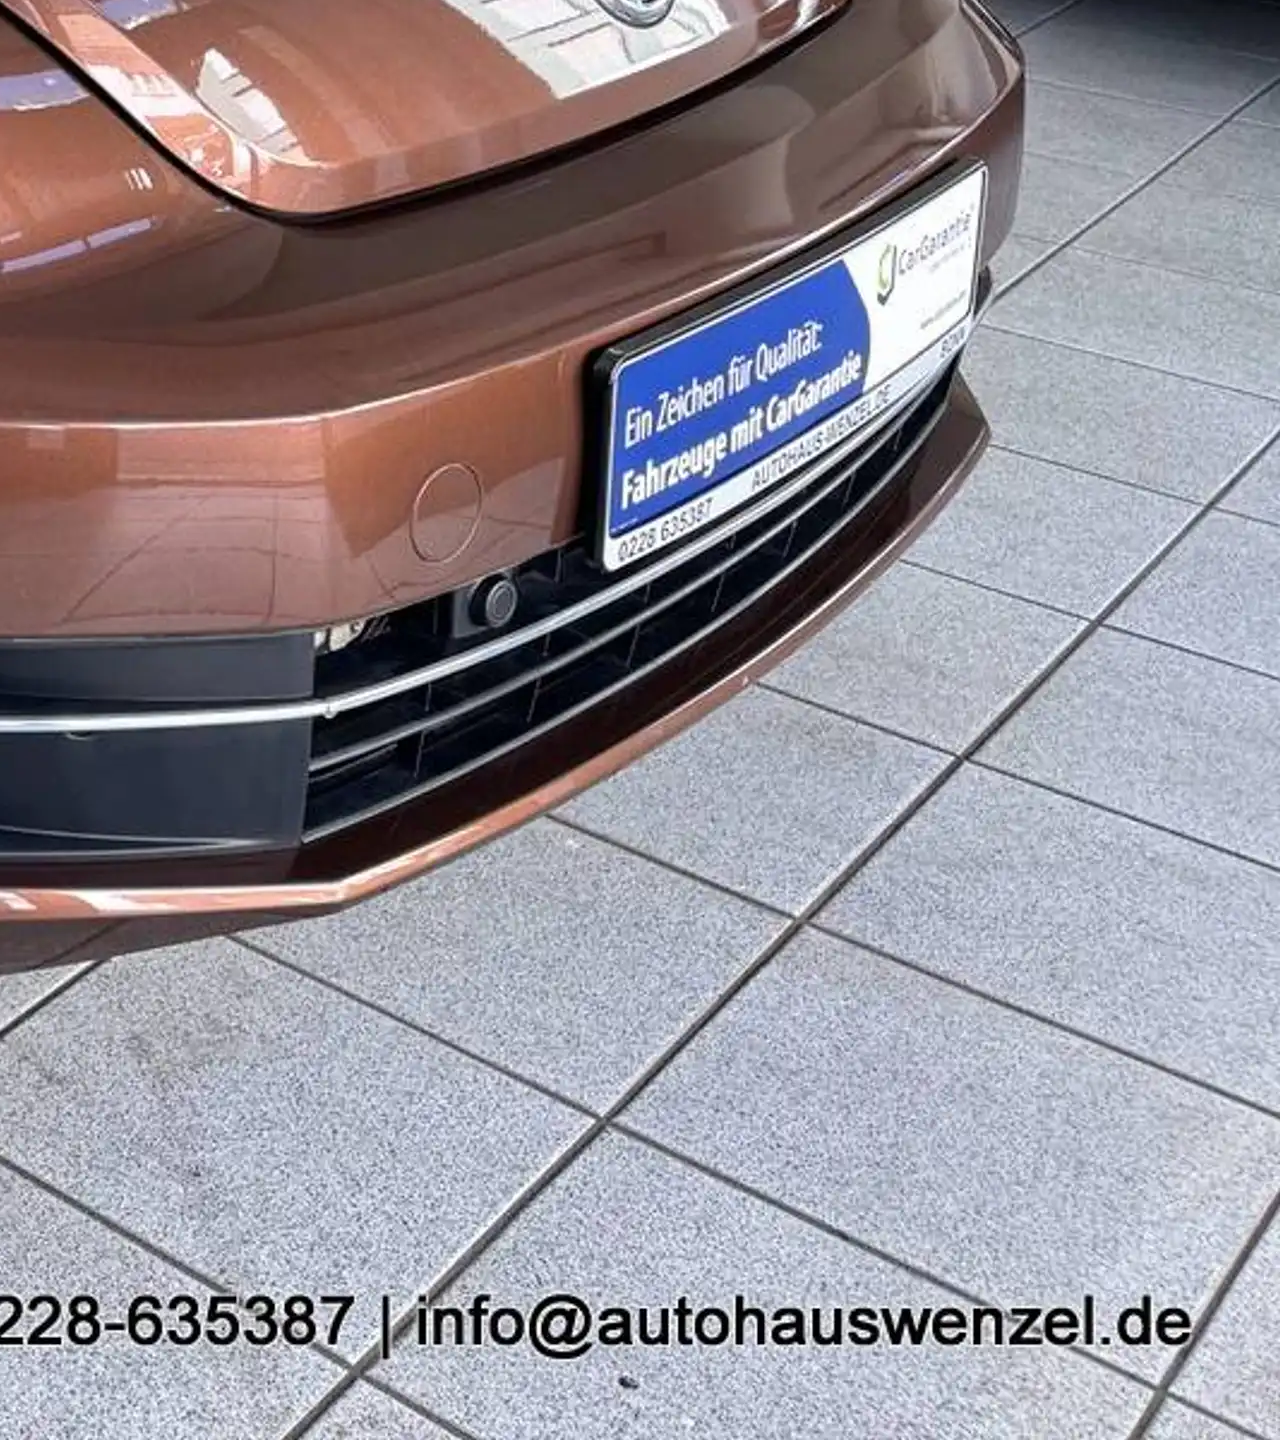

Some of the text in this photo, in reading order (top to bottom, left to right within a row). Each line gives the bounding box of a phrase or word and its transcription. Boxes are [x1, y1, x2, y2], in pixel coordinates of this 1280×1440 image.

[898, 207, 973, 276] CarGarantie
[621, 349, 863, 510] Fahrzeuge mit CarGarantie
[624, 406, 653, 449] Ein
[655, 373, 725, 433] Zeichen
[727, 355, 755, 396] für
[617, 527, 657, 562] 0228
[660, 496, 715, 543] 635387
